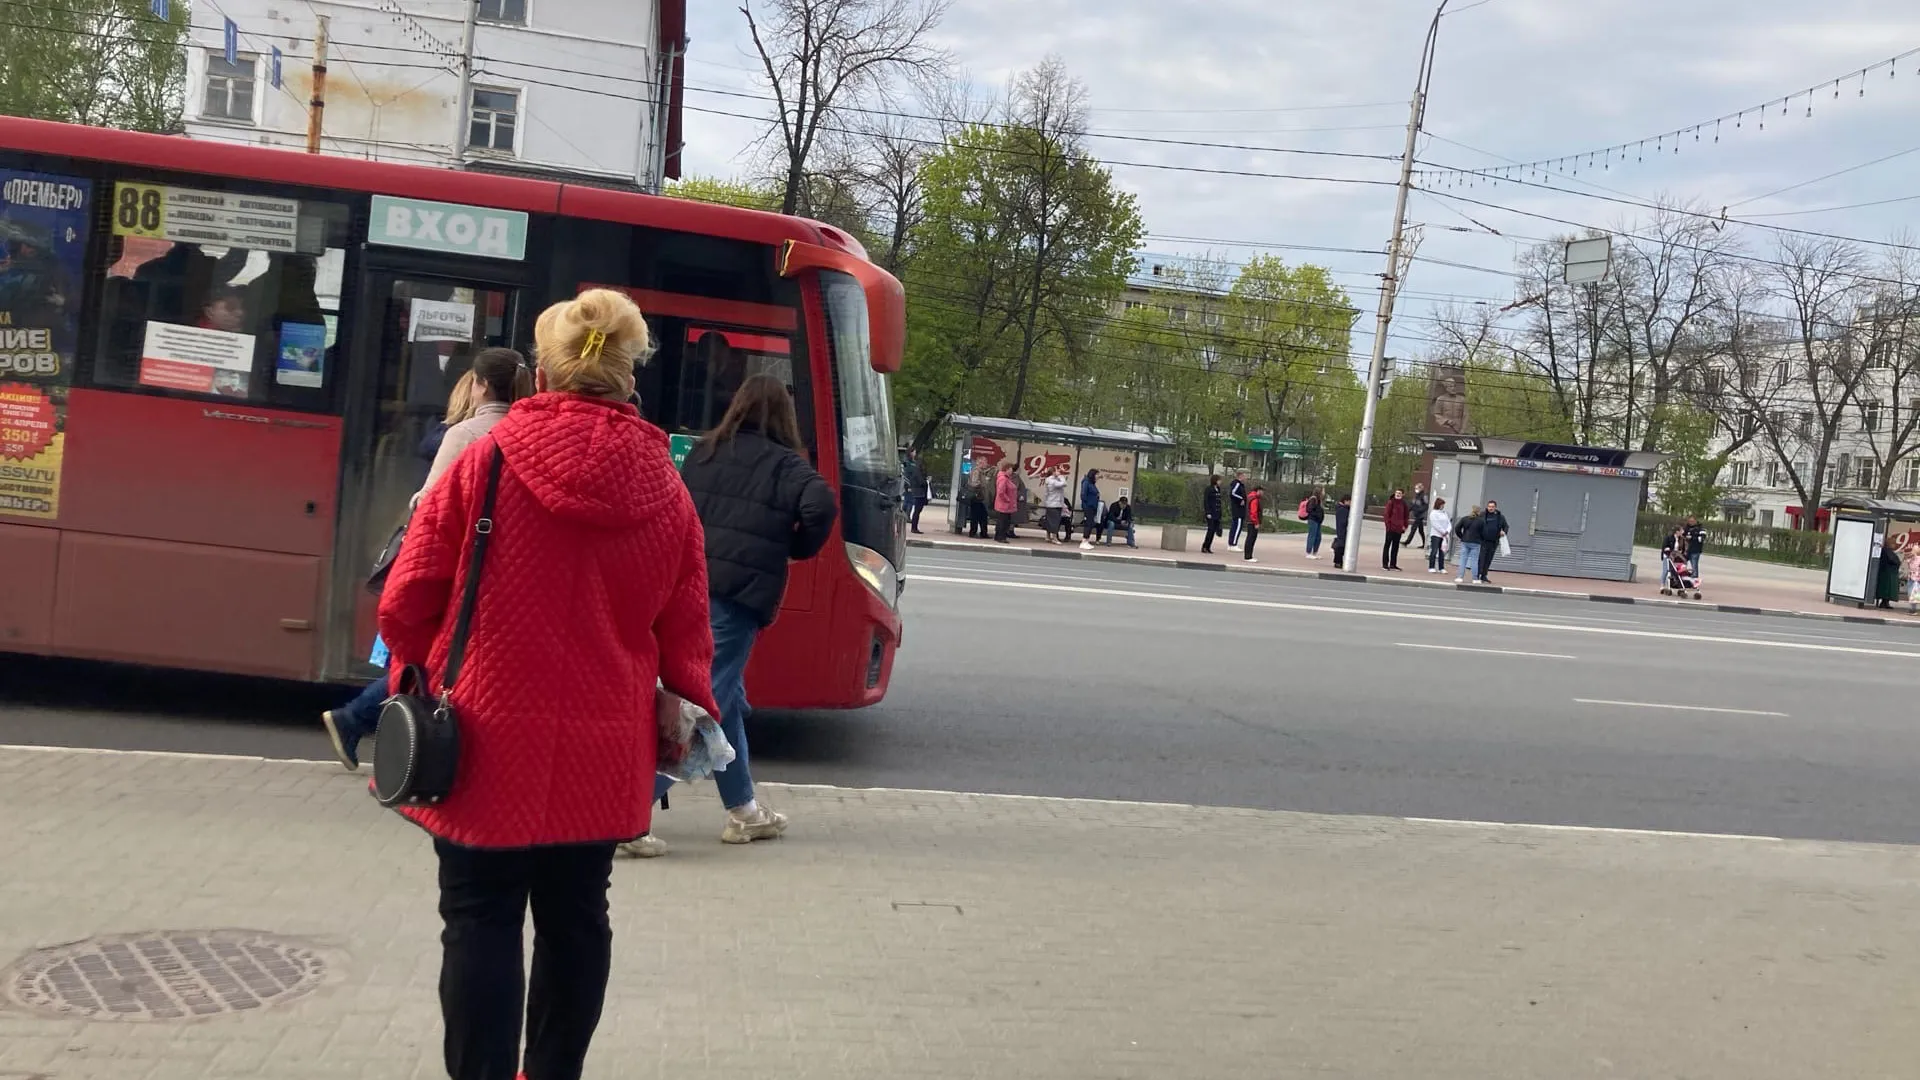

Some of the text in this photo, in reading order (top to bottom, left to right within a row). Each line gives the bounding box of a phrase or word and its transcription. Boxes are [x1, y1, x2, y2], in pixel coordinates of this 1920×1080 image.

[3, 178, 83, 210] «ПРЕМЬЕР»
[118, 186, 161, 231] 88
[65, 226, 77, 243] 0+
[385, 205, 509, 255] ВХОД
[2, 427, 30, 443] 350
[1028, 455, 1046, 477] 9
[1894, 532, 1910, 553] 9
